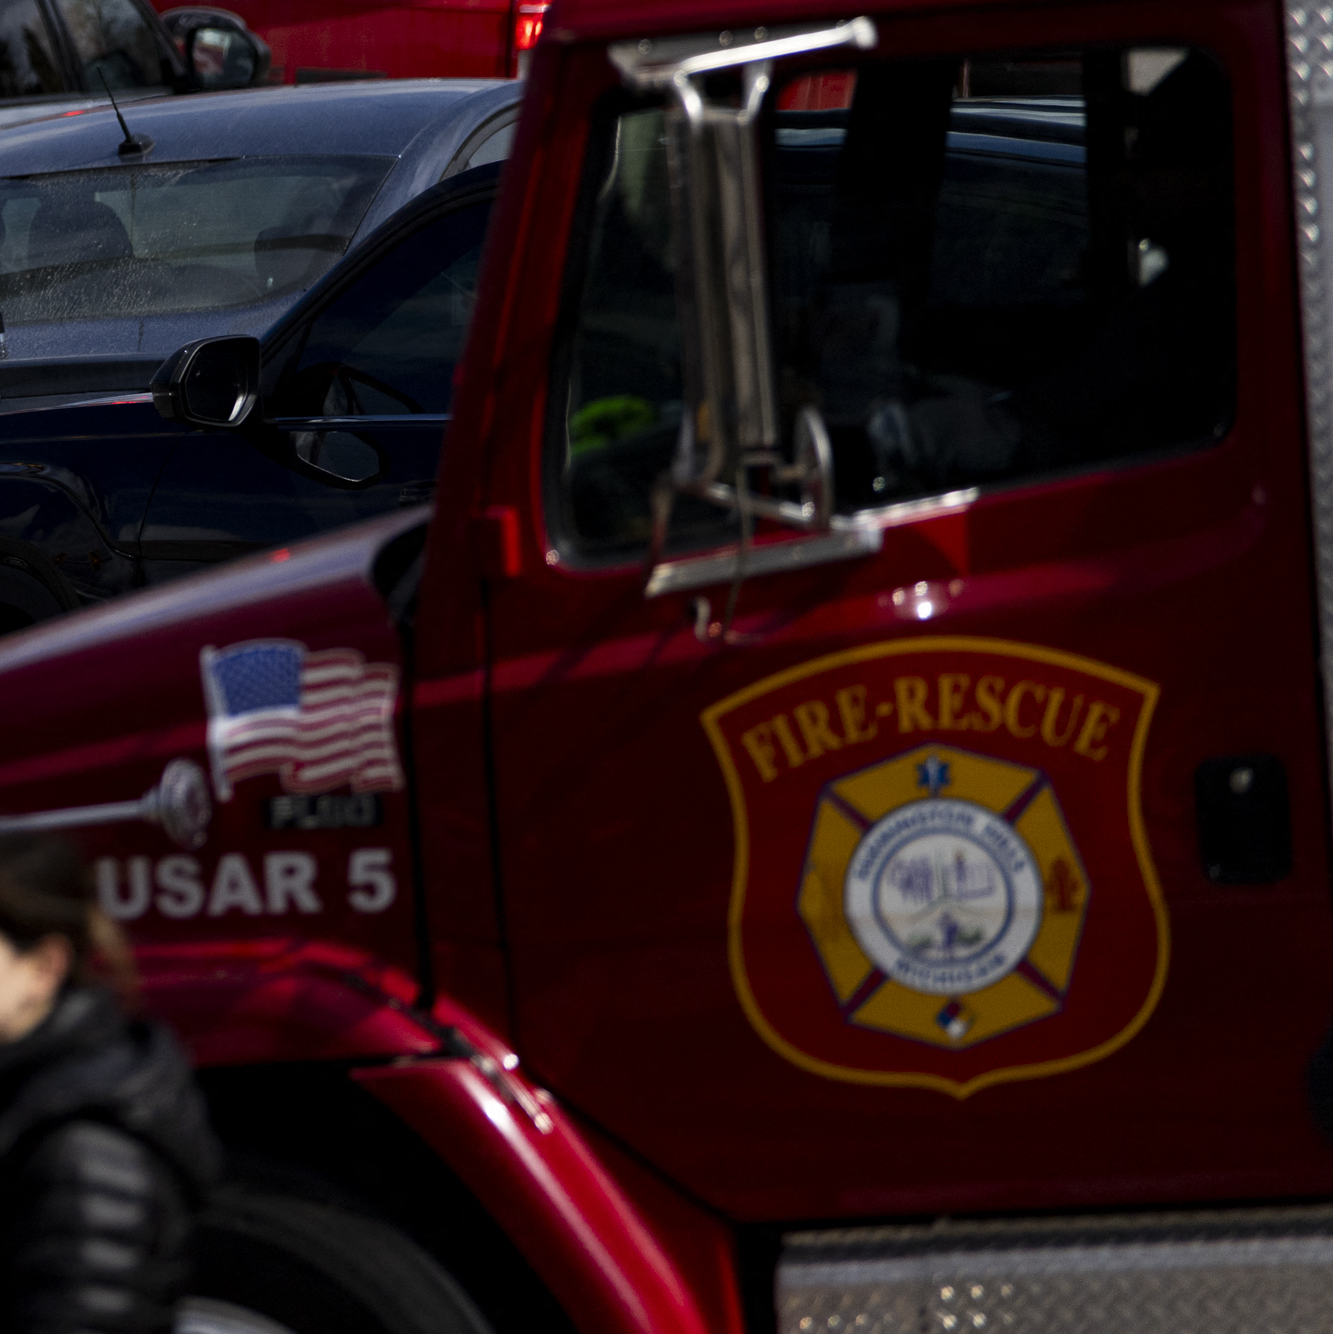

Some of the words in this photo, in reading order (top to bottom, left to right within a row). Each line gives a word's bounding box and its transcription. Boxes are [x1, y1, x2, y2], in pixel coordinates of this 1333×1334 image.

[741, 671, 1121, 783] FIRE-RESCUE
[94, 850, 323, 920] USAR
[346, 847, 398, 915] 5
